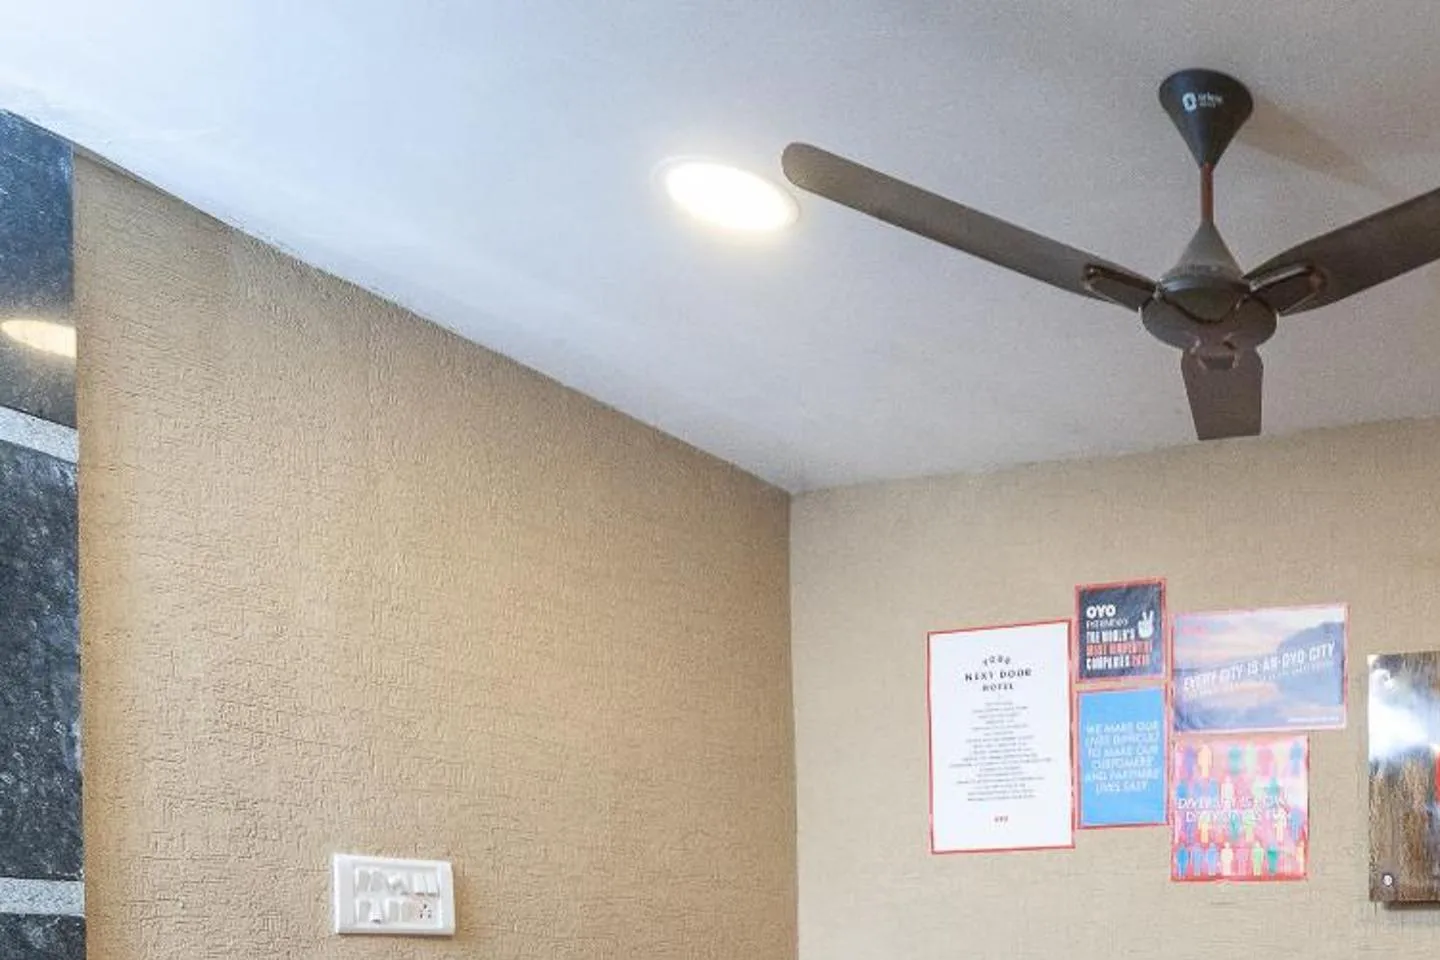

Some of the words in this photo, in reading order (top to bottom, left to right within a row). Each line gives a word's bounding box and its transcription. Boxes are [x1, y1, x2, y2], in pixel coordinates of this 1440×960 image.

[1086, 604, 1116, 619] OYO
[1219, 663, 1243, 682] CITY
[1281, 649, 1305, 668] OYO
[1308, 641, 1336, 661] CITY
[965, 671, 994, 681] NEXT
[999, 667, 1032, 679] DOOR
